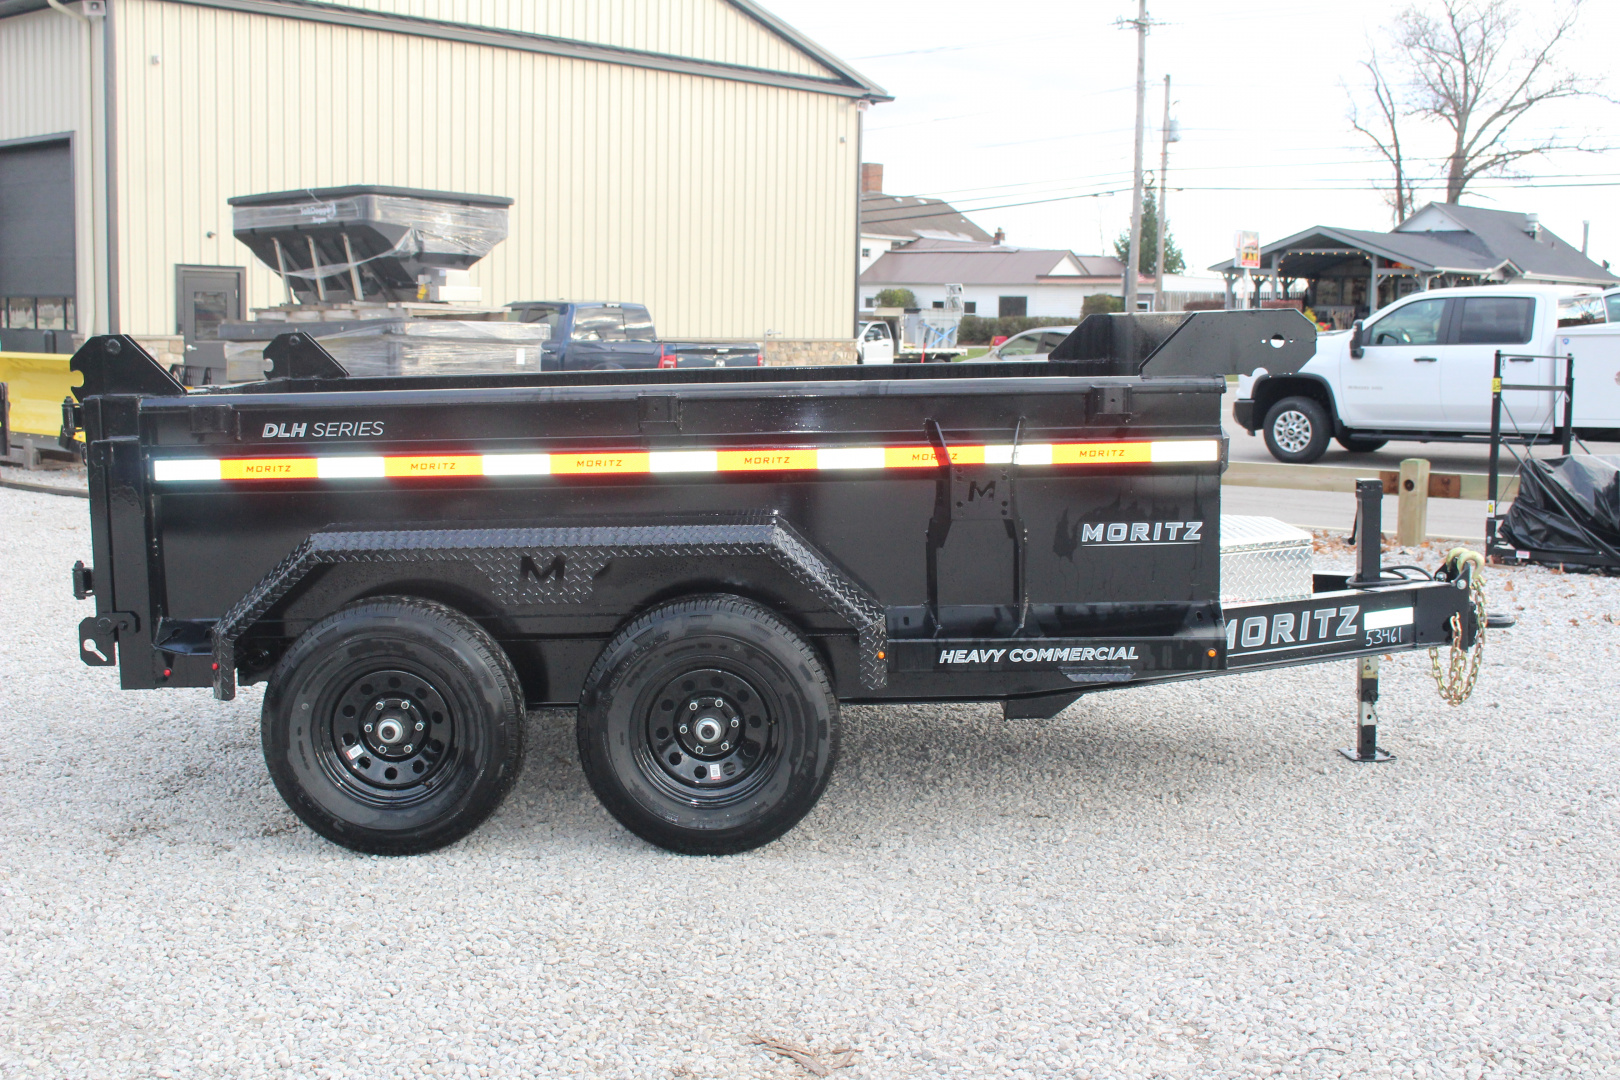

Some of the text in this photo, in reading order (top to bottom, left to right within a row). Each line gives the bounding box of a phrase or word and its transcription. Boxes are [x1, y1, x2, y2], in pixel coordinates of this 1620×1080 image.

[262, 421, 385, 438] DLH SERIES
[1079, 449, 1125, 457] MORITZ
[576, 459, 623, 467] MORITZ
[744, 456, 791, 465] MORITZ
[246, 465, 291, 473] MORITZ
[410, 462, 456, 470] MORITZ
[1081, 521, 1203, 543] MORITZ
[1365, 627, 1402, 647] 53461
[939, 646, 1139, 664] HEAVY COMMERCIAL
